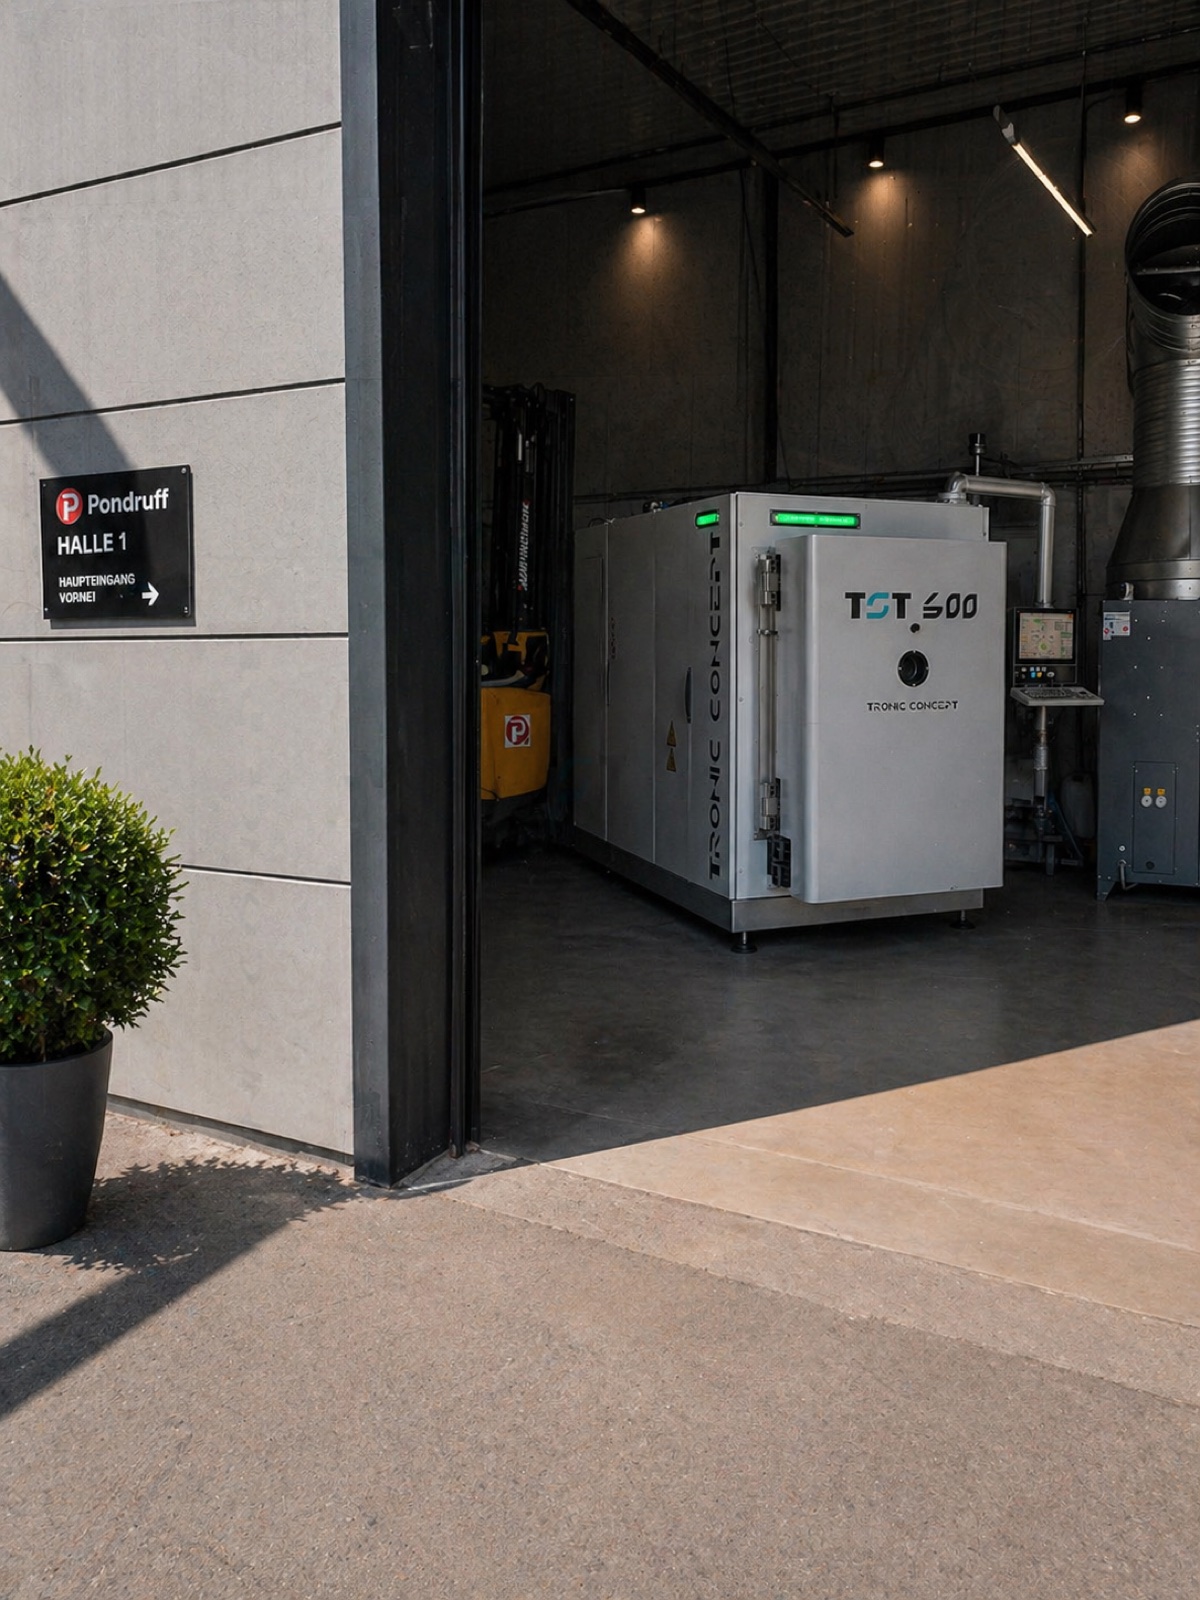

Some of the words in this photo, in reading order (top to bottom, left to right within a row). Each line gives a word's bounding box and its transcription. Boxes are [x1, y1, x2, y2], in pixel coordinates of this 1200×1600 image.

[88, 488, 169, 515] Pondruff
[57, 533, 114, 555] HALLE
[118, 531, 127, 551] 1
[58, 573, 136, 588] HAUPTEINGANG
[845, 592, 912, 619] TST
[922, 592, 978, 619] 600
[709, 532, 721, 722] CONCEPT
[866, 701, 906, 712] TRONIC
[909, 700, 959, 711] CONCEPT
[709, 739, 721, 879] TRONIC
